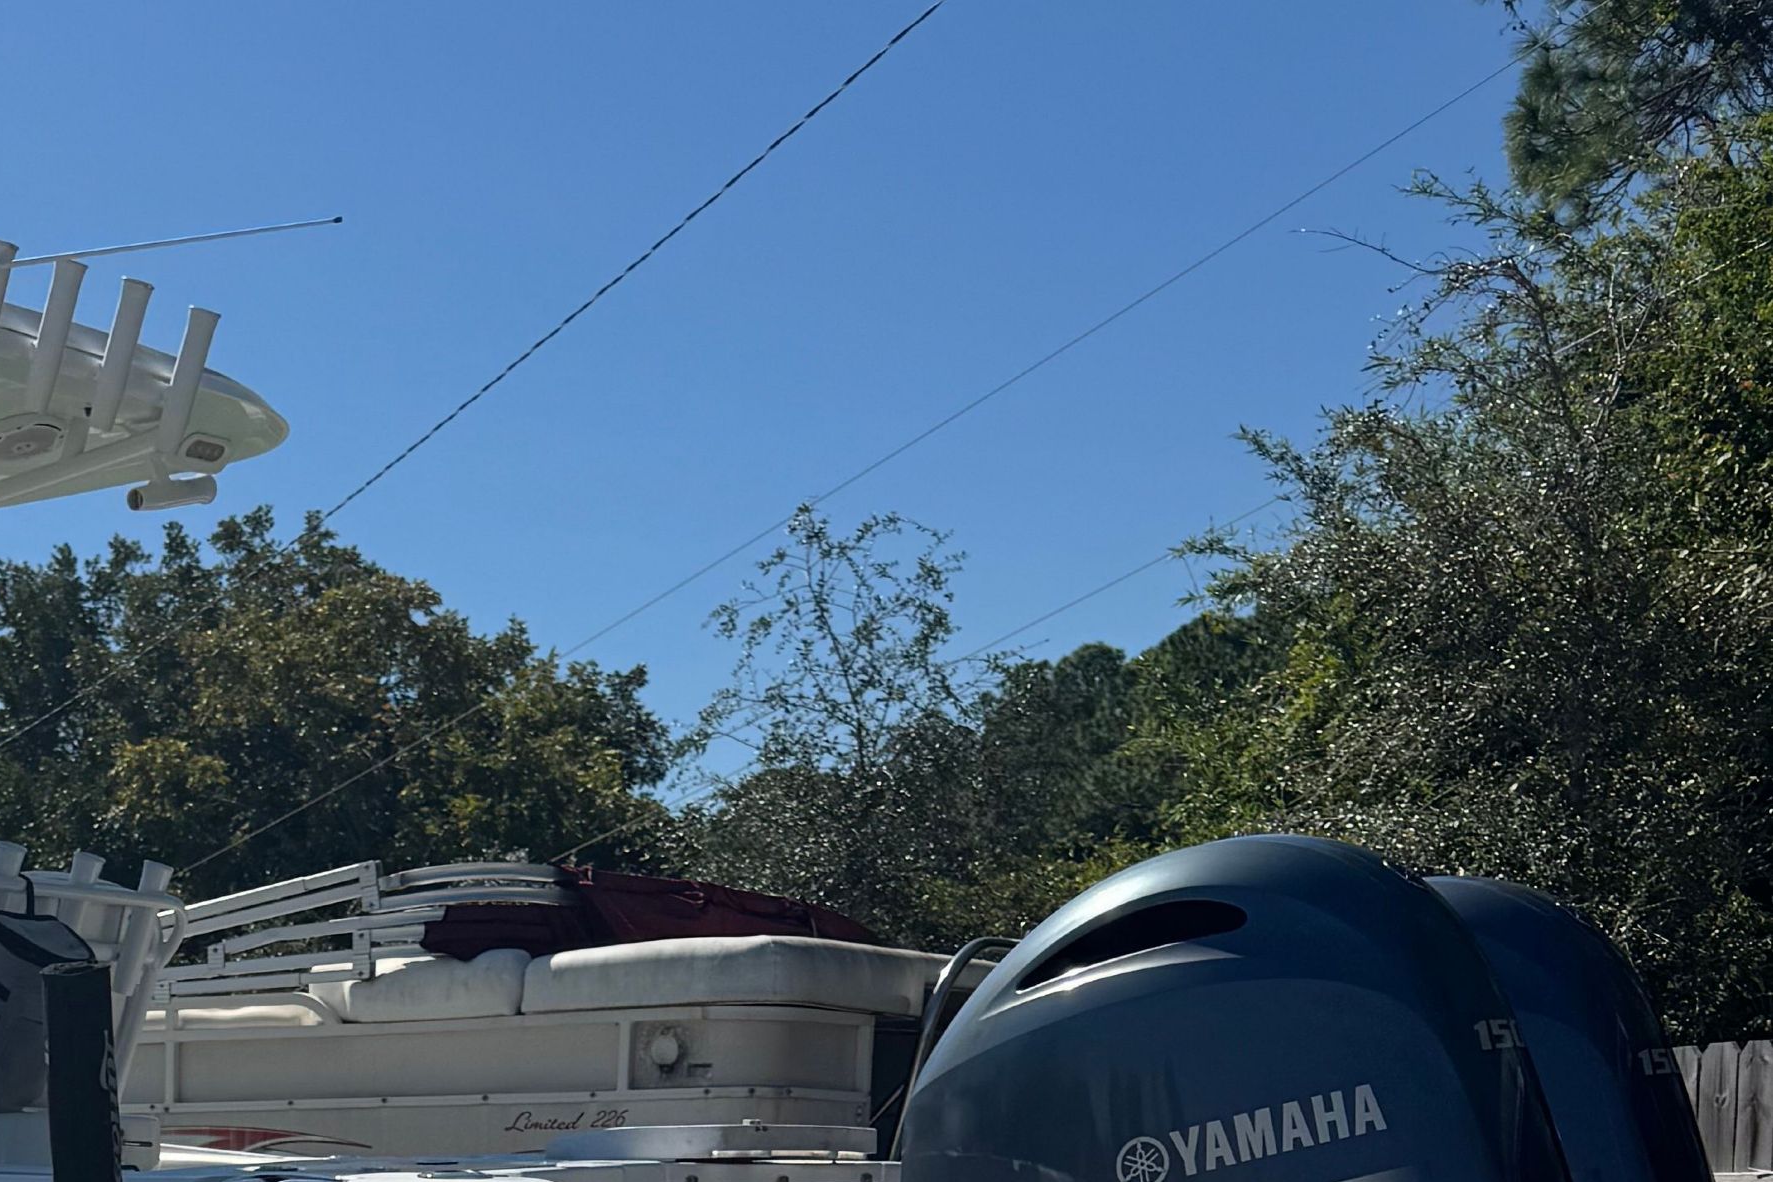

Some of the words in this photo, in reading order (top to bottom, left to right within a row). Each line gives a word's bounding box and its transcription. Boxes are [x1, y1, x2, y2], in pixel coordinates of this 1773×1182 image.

[504, 1111, 585, 1132] Limited
[589, 1109, 629, 1129] 226
[1168, 1083, 1388, 1177] YAMAHA
